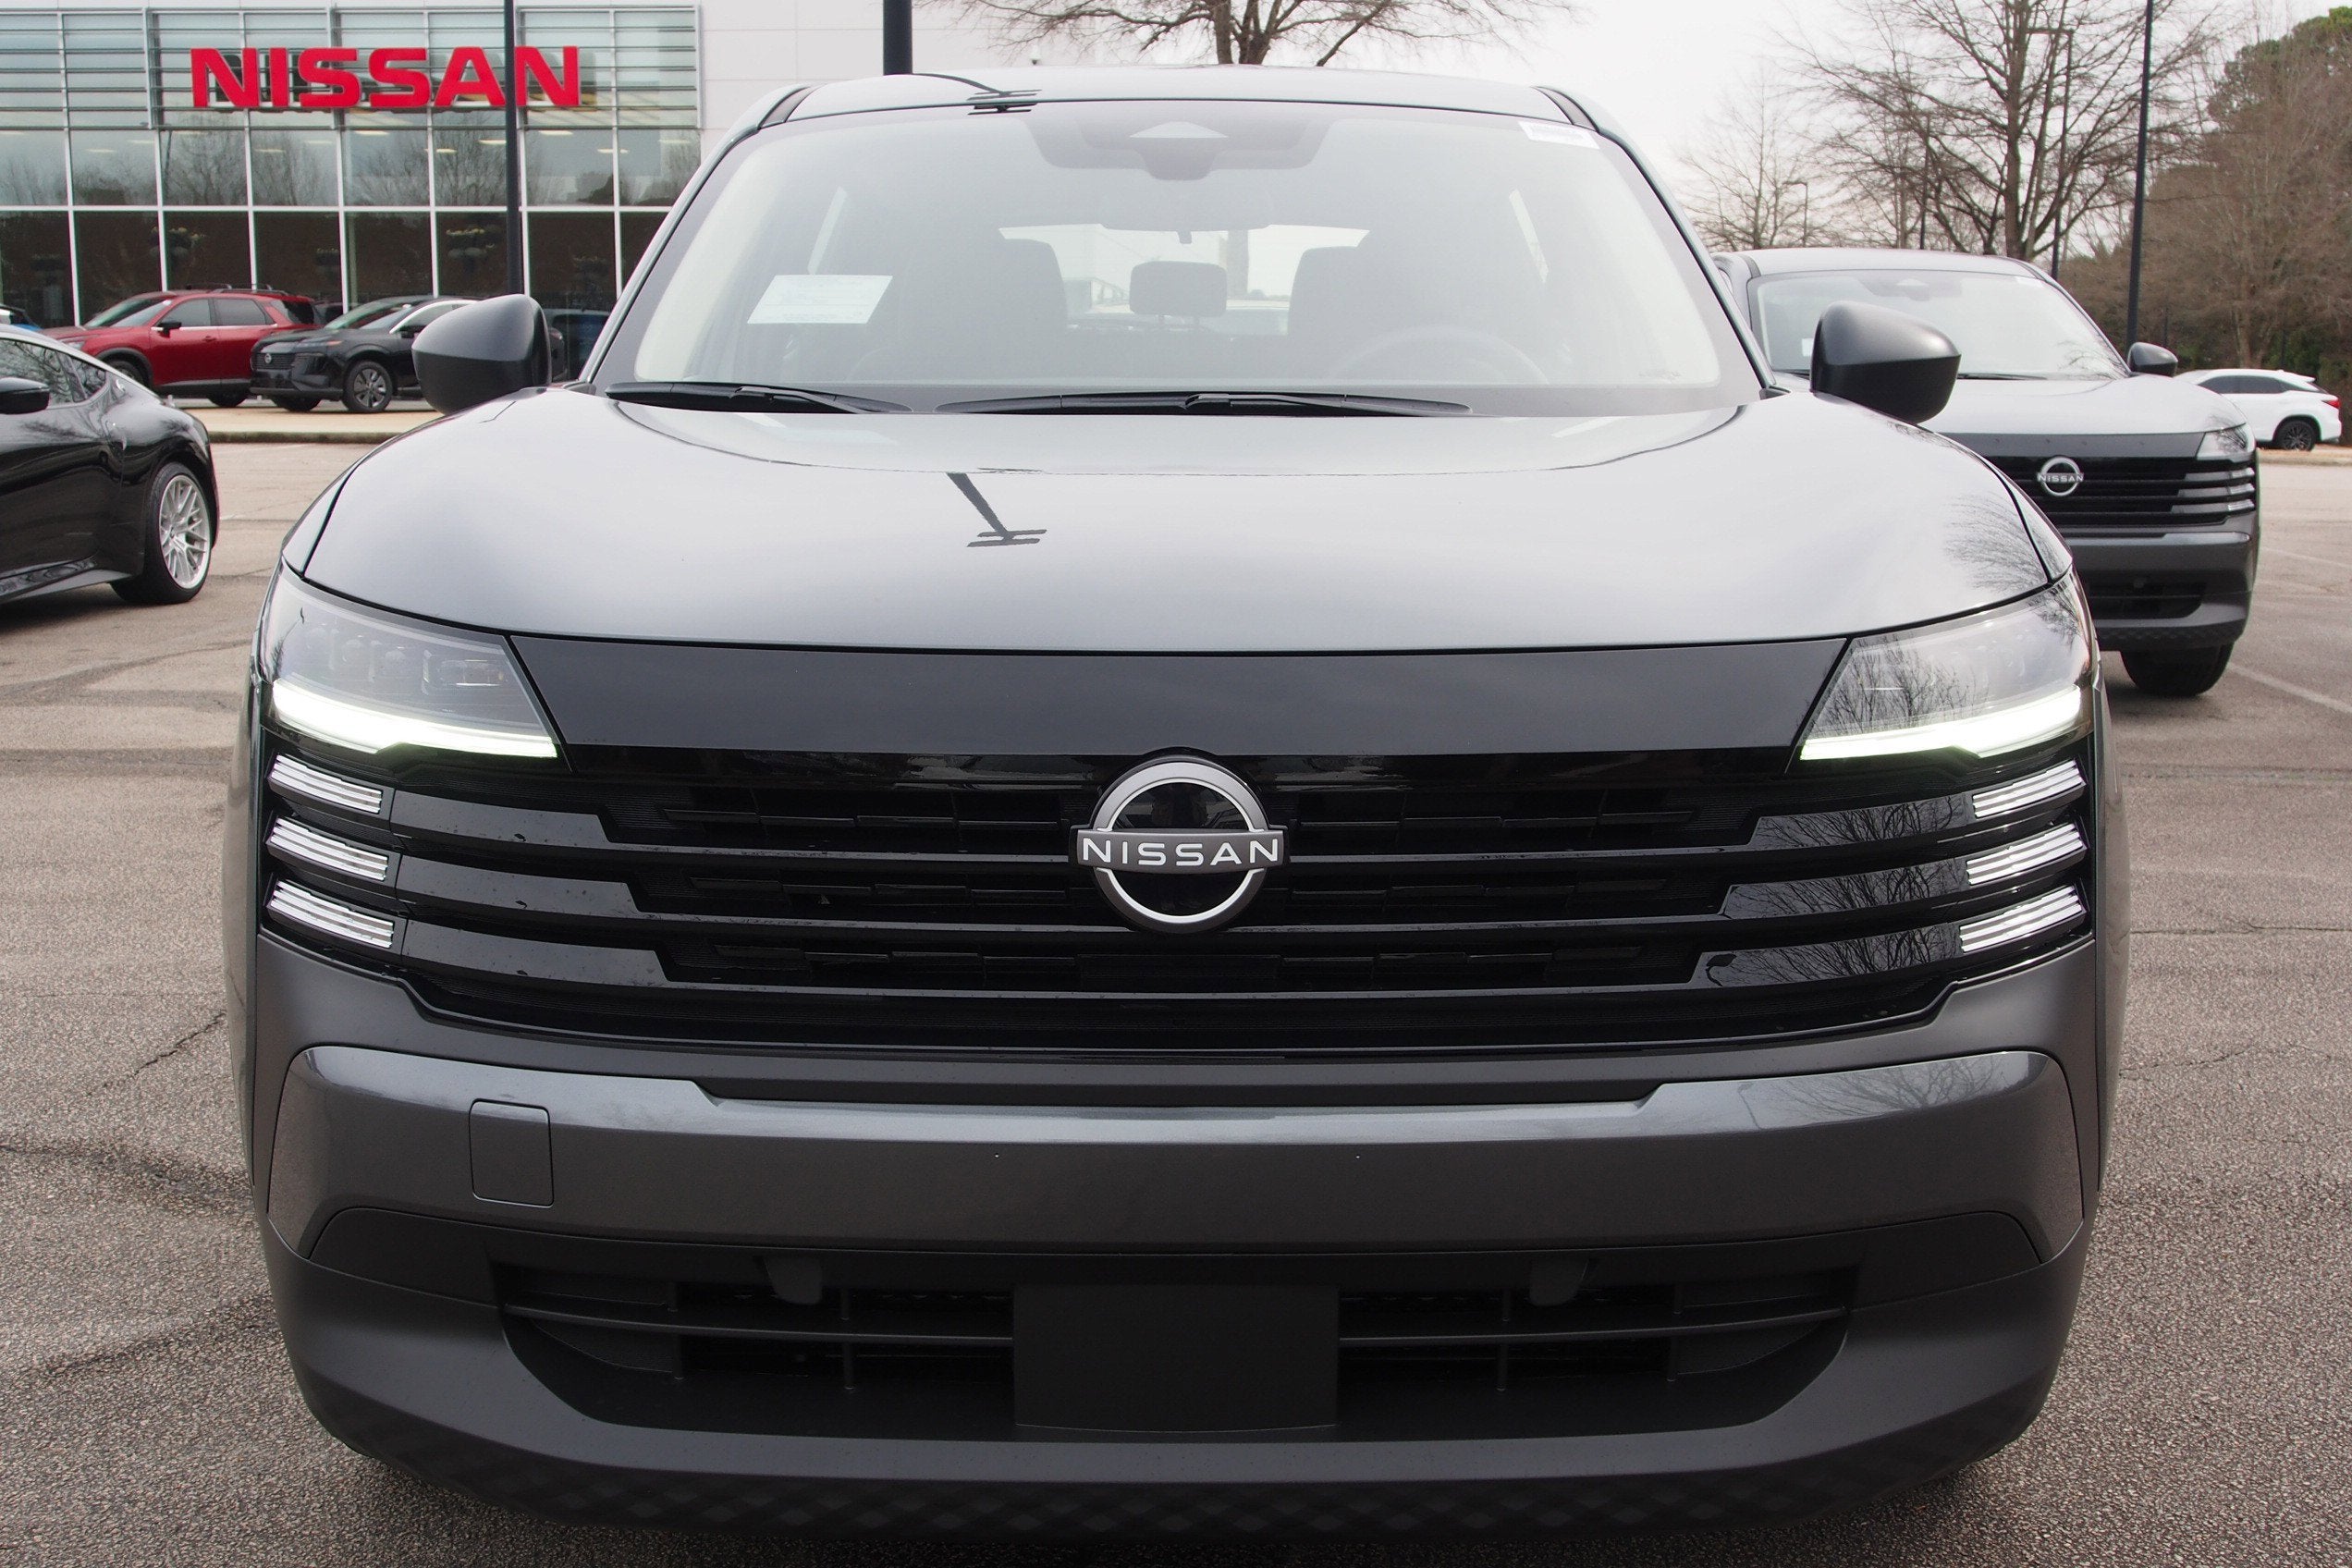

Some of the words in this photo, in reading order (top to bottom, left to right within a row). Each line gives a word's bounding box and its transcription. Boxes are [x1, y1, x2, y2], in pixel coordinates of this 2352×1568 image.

[190, 46, 580, 107] NISSAN
[2037, 472, 2084, 483] NISSAN
[1083, 838, 1278, 866] NISSAN
